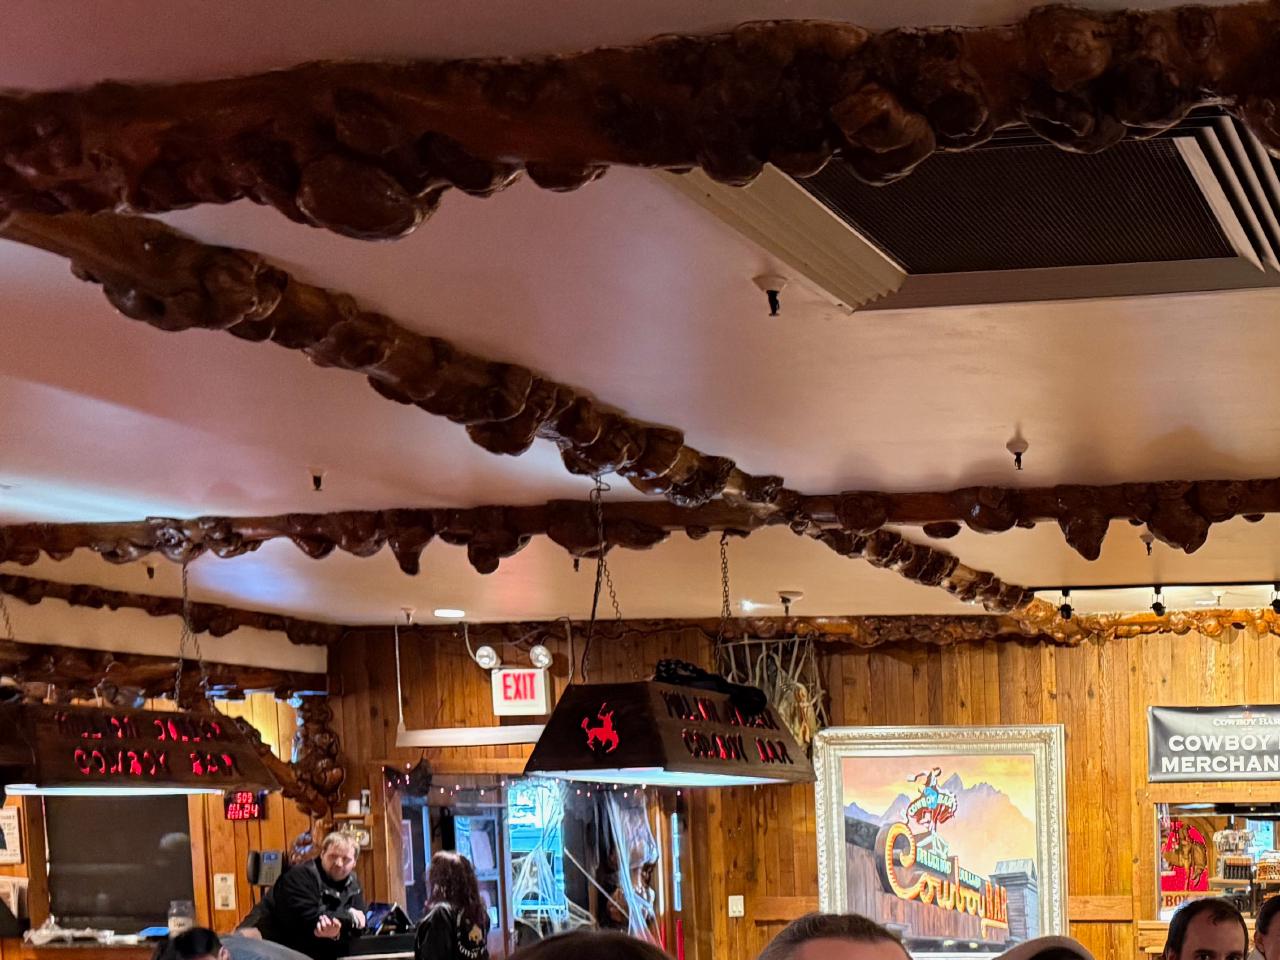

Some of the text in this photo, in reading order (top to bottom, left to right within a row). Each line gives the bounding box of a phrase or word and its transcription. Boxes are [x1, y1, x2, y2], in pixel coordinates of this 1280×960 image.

[502, 673, 536, 700] EXIT
[1213, 716, 1280, 727] COWBOY BAR
[1168, 734, 1272, 752] COWBOY
